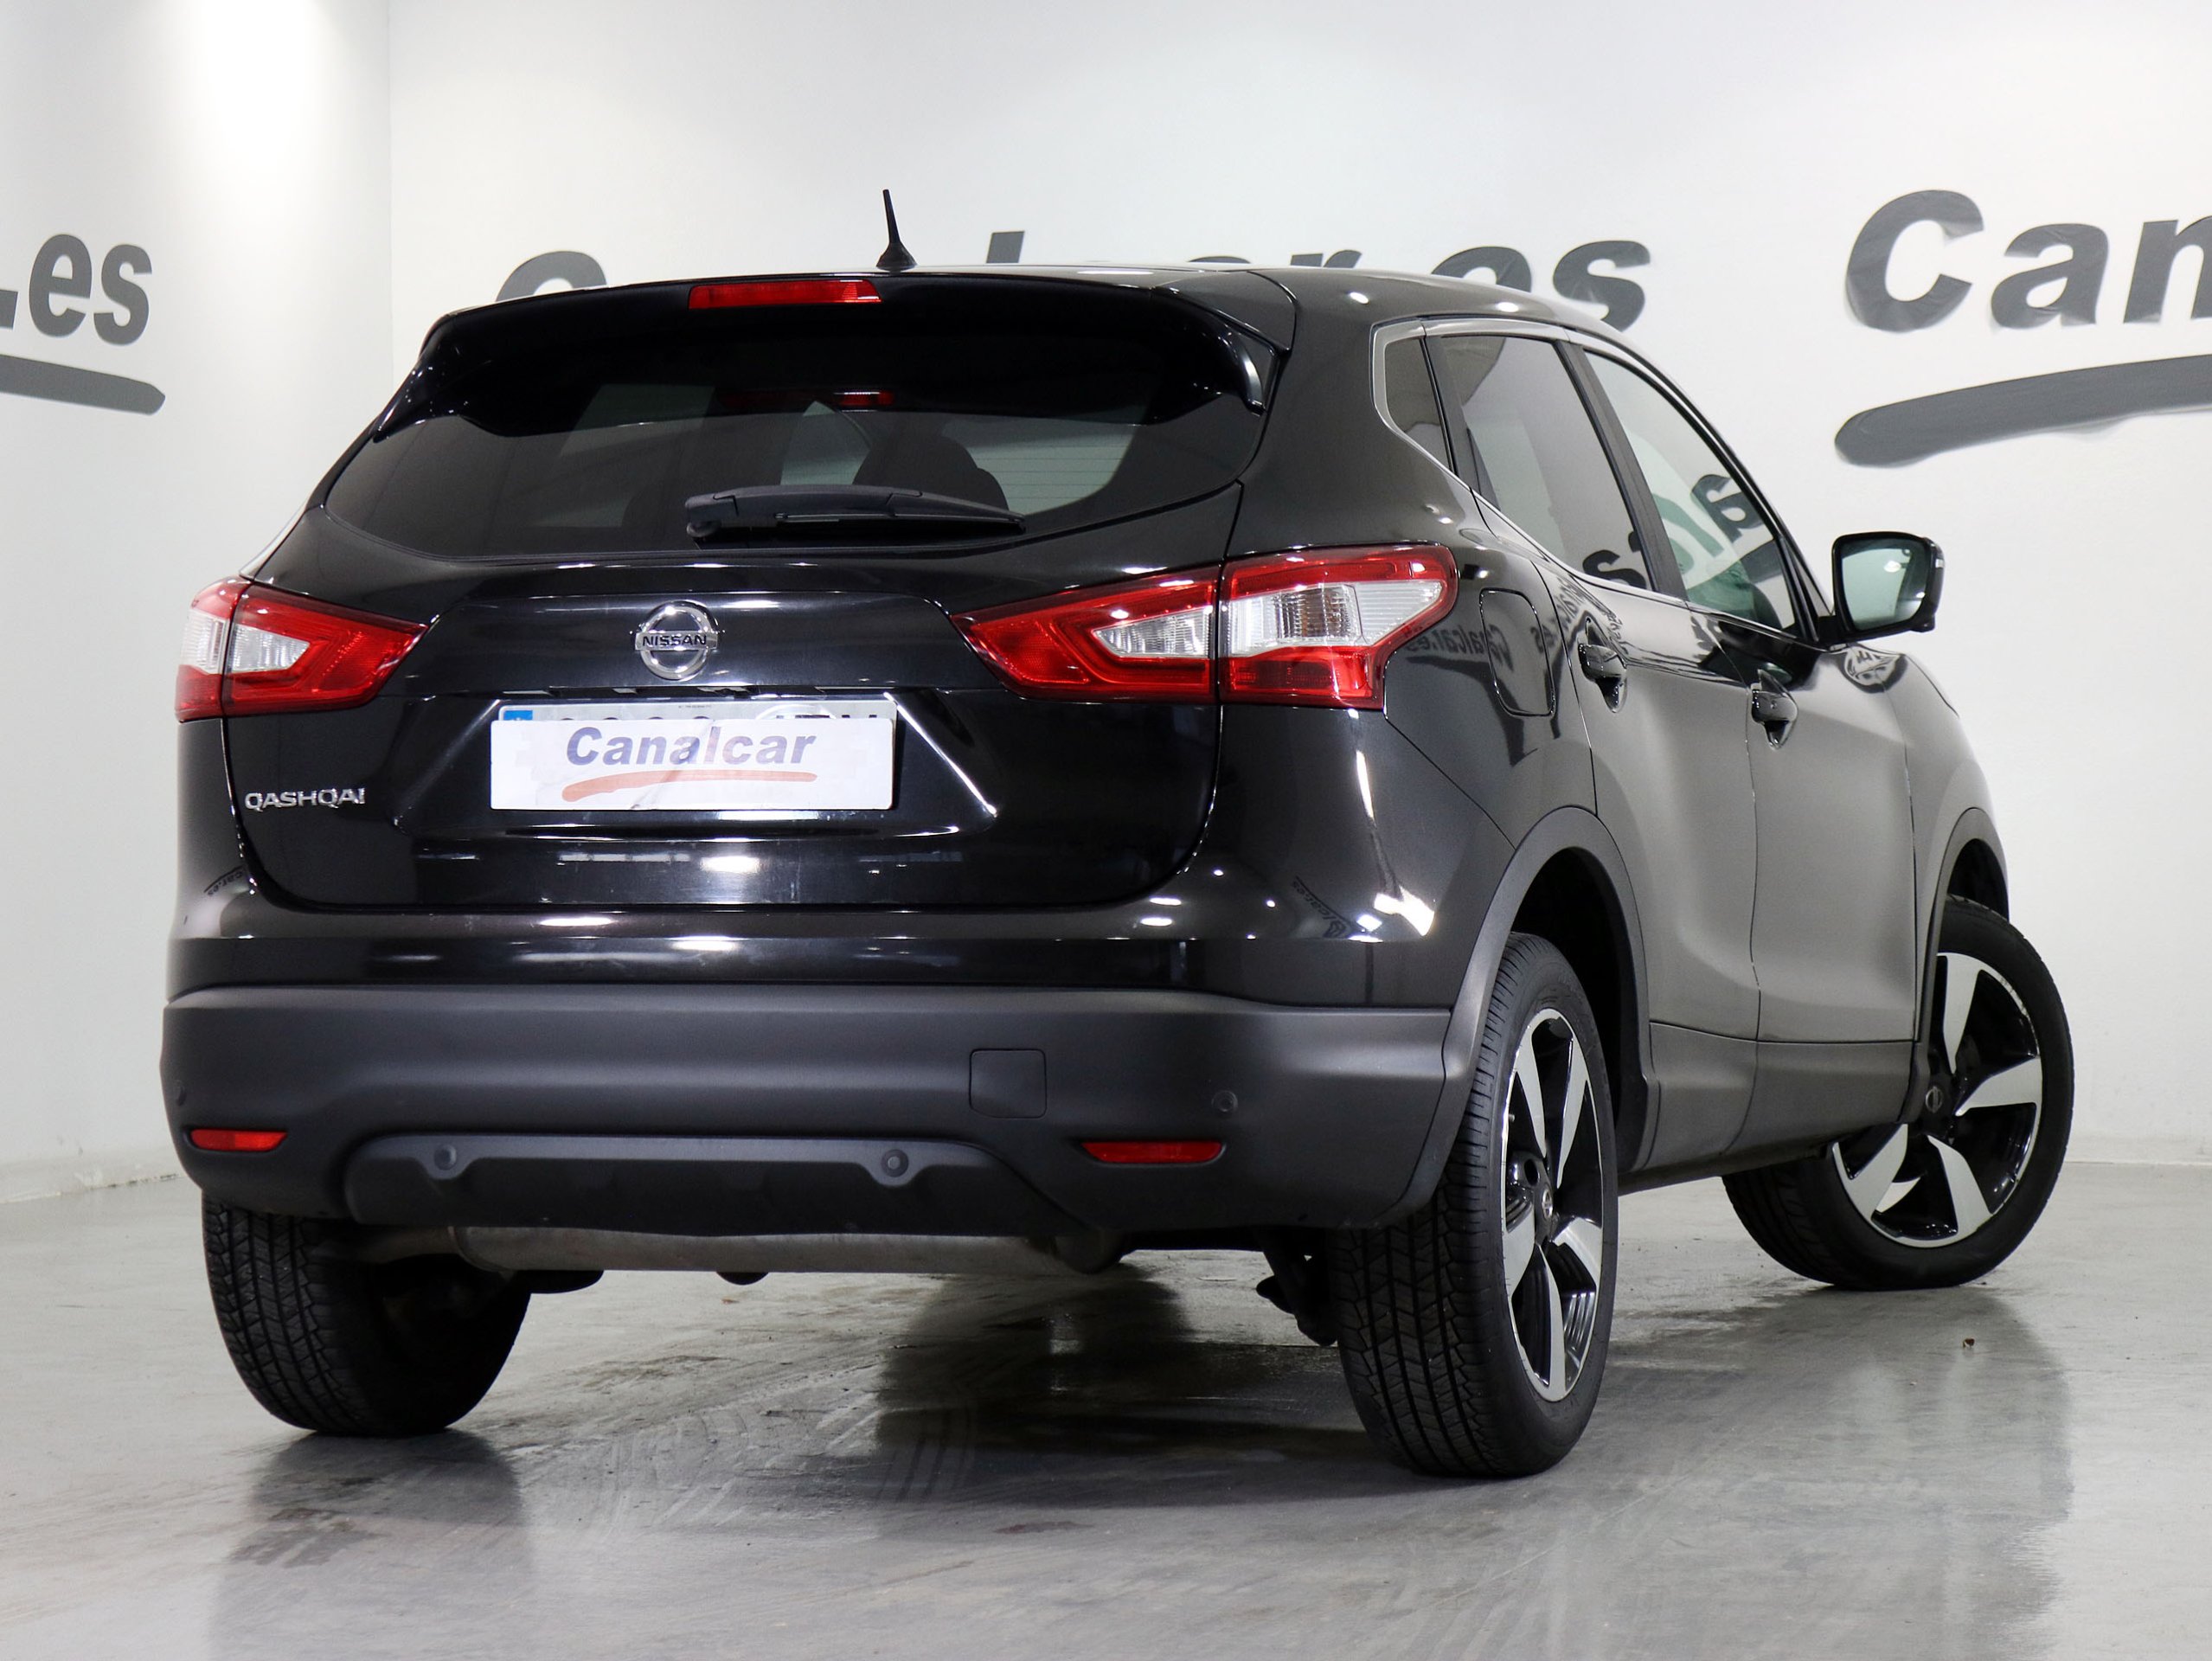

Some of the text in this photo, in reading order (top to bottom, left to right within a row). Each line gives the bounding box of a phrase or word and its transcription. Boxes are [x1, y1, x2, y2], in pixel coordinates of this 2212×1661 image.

[1845, 189, 2212, 333] Can
[642, 633, 708, 647] NISSAN
[566, 726, 817, 766] Canalcar
[244, 787, 366, 812] QASHQAI
